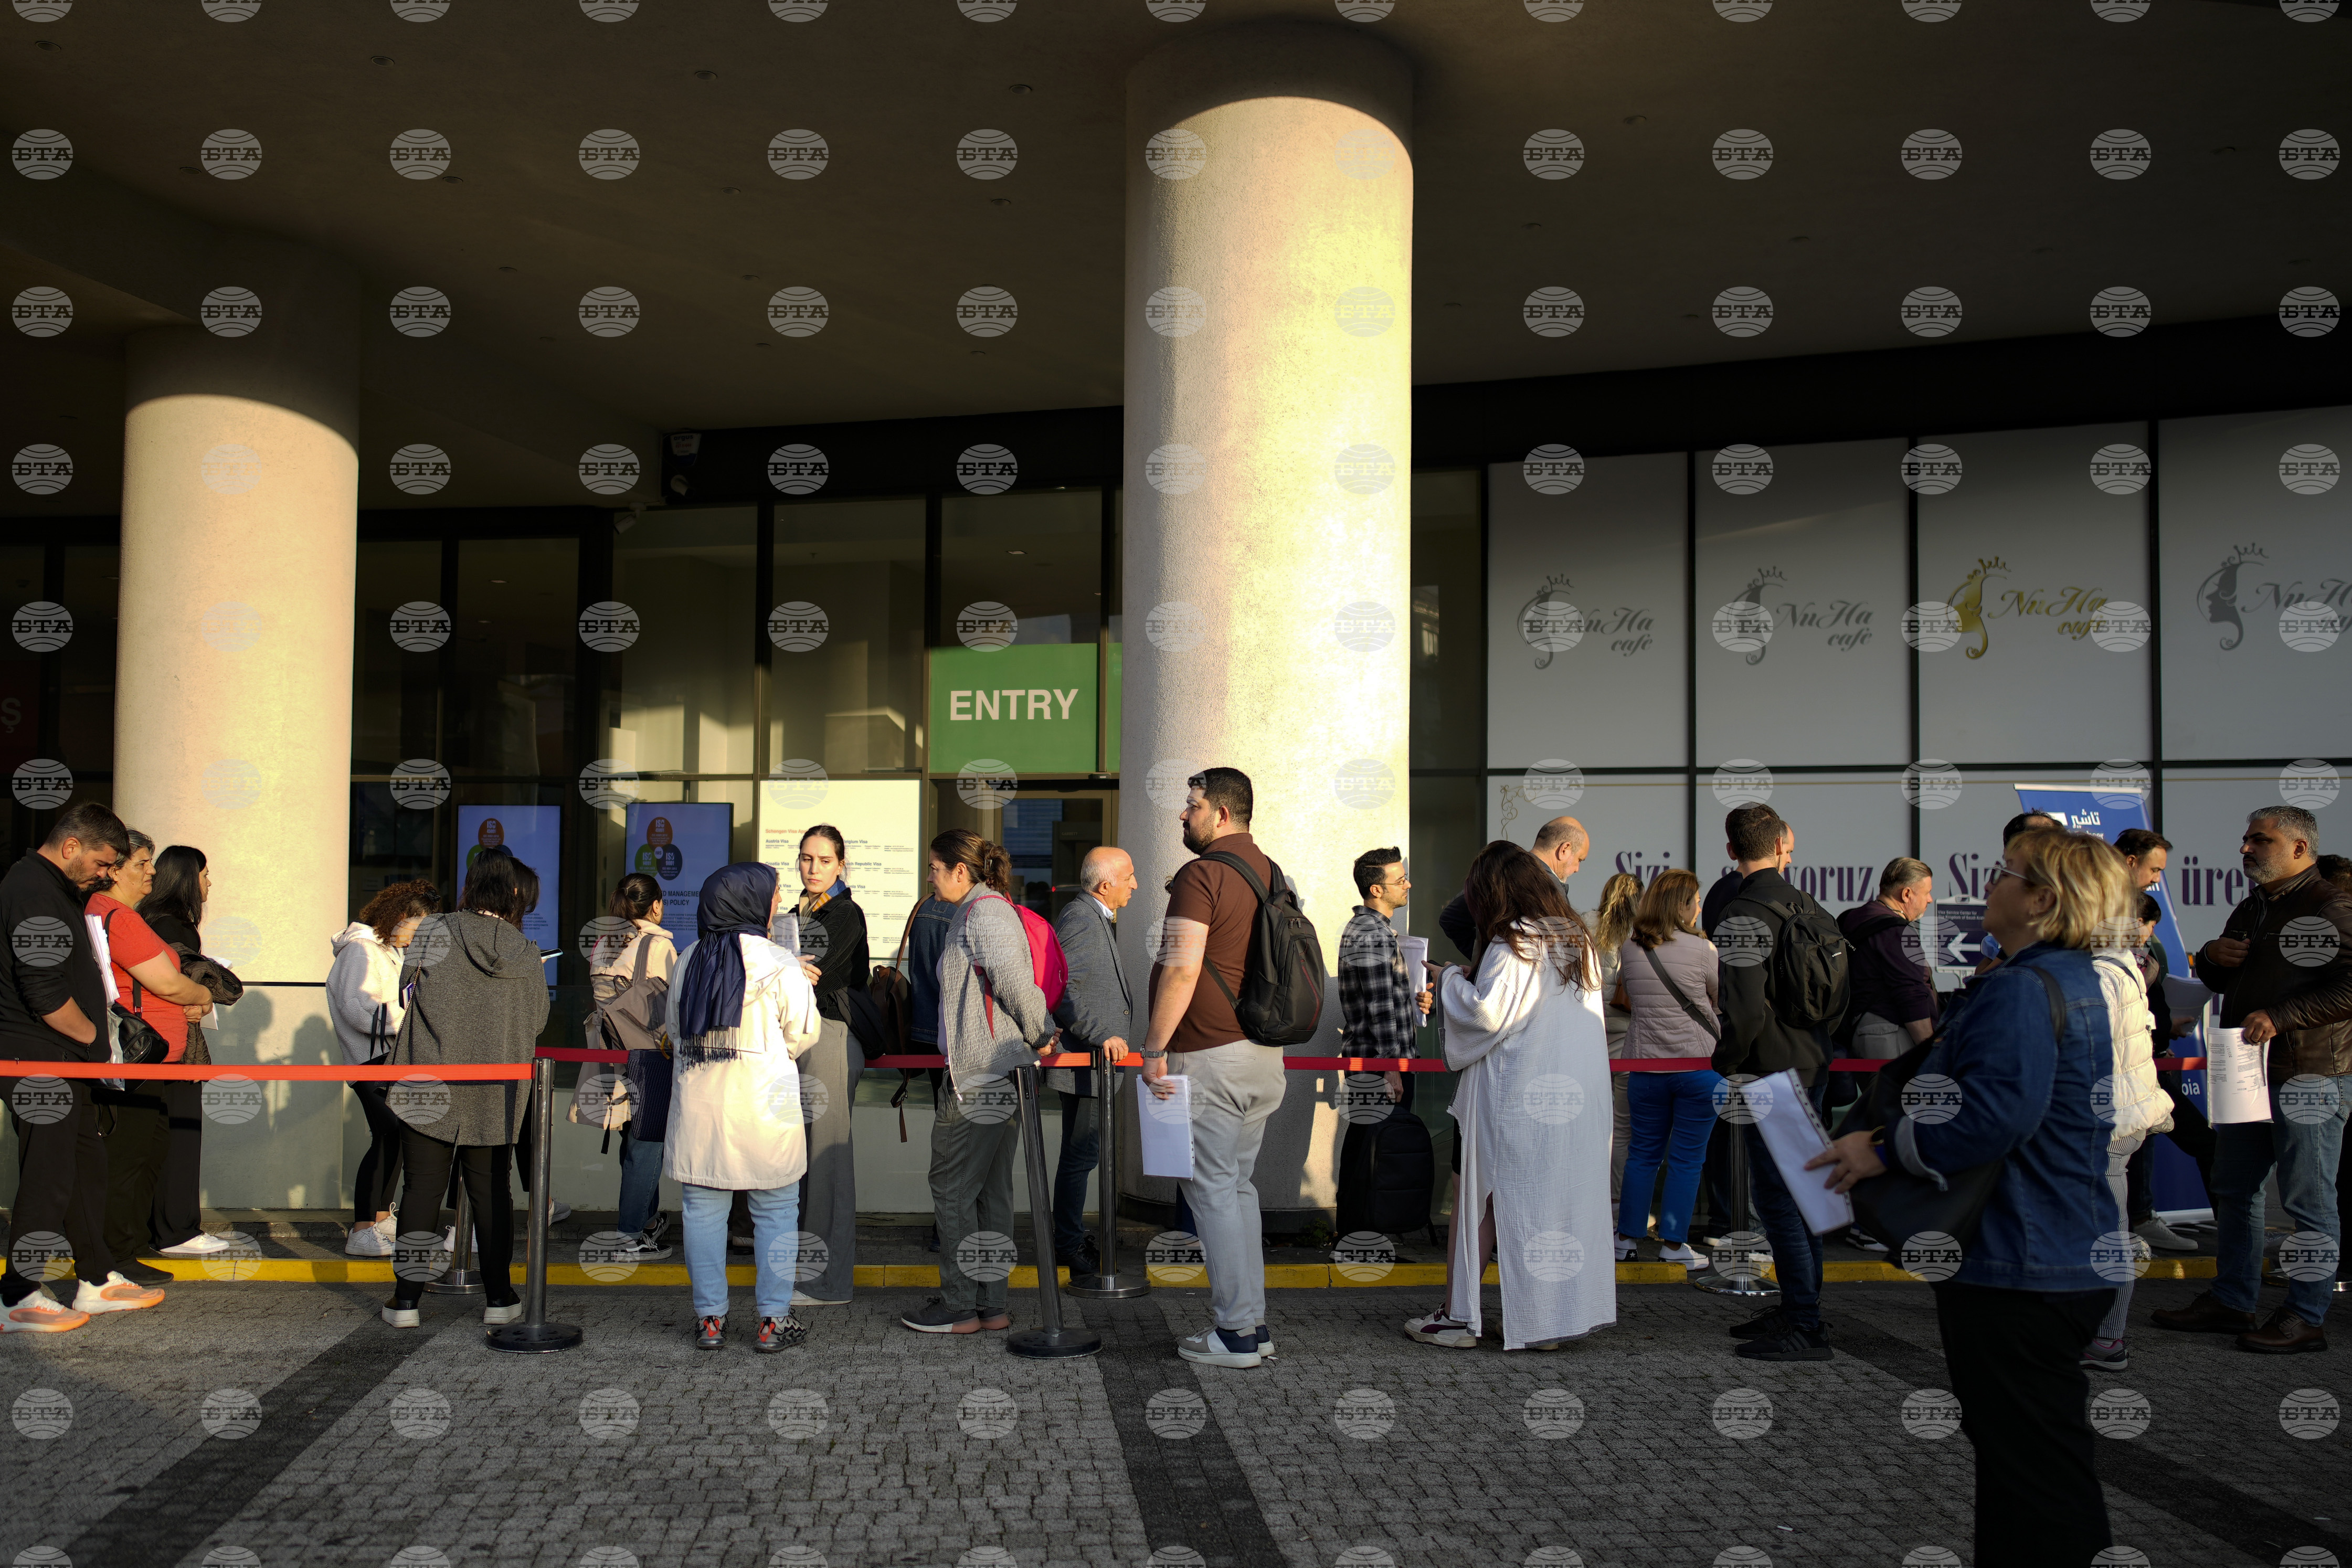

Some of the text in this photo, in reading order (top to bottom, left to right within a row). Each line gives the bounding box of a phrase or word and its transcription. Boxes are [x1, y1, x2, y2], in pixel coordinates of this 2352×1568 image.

[1988, 586, 2107, 619] NuHa
[2241, 578, 2352, 613] NuH
[1, 697, 21, 733] Ş
[950, 689, 1078, 721] ENTRY
[2071, 809, 2101, 829] تاشير
[2181, 856, 2256, 906] üre
